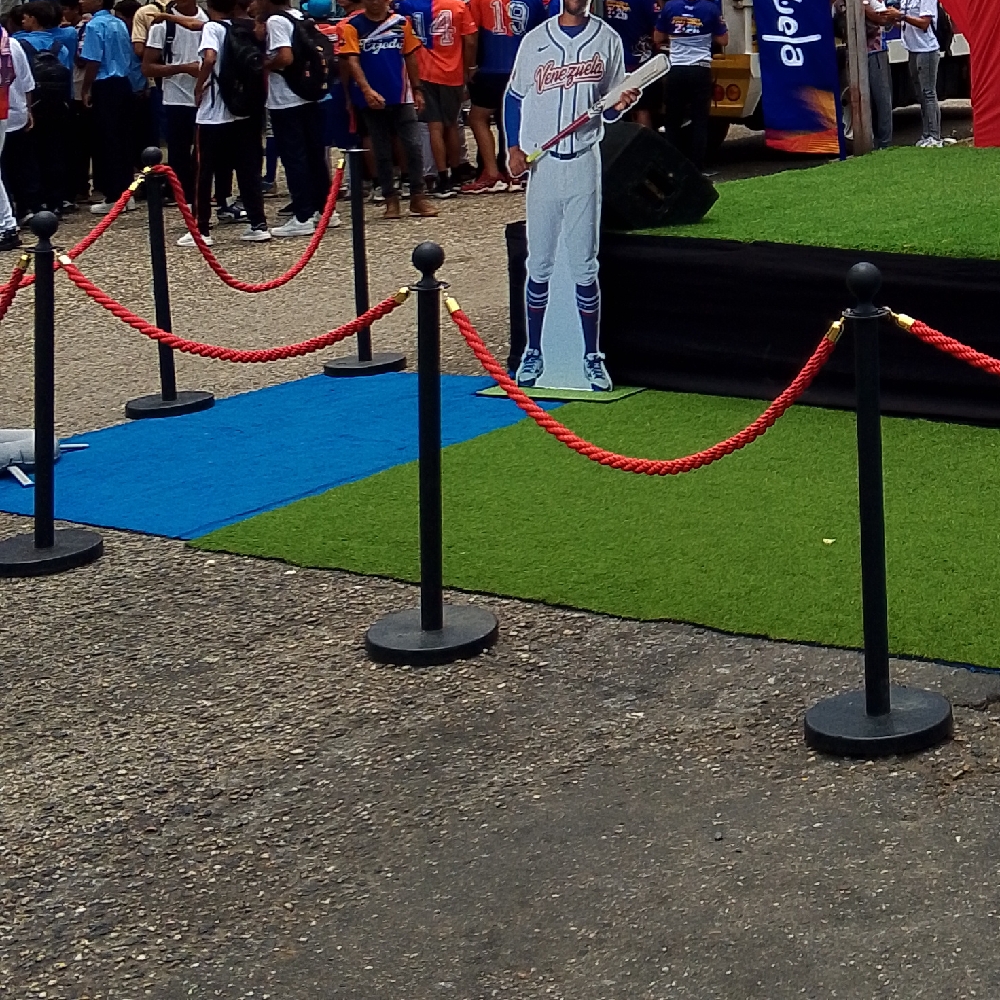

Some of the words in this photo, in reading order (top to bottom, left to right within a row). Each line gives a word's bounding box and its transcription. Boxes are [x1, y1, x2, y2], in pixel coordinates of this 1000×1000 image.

[412, 10, 456, 46] 14
[490, 0, 529, 35] 19
[534, 51, 605, 94] Venezuela
